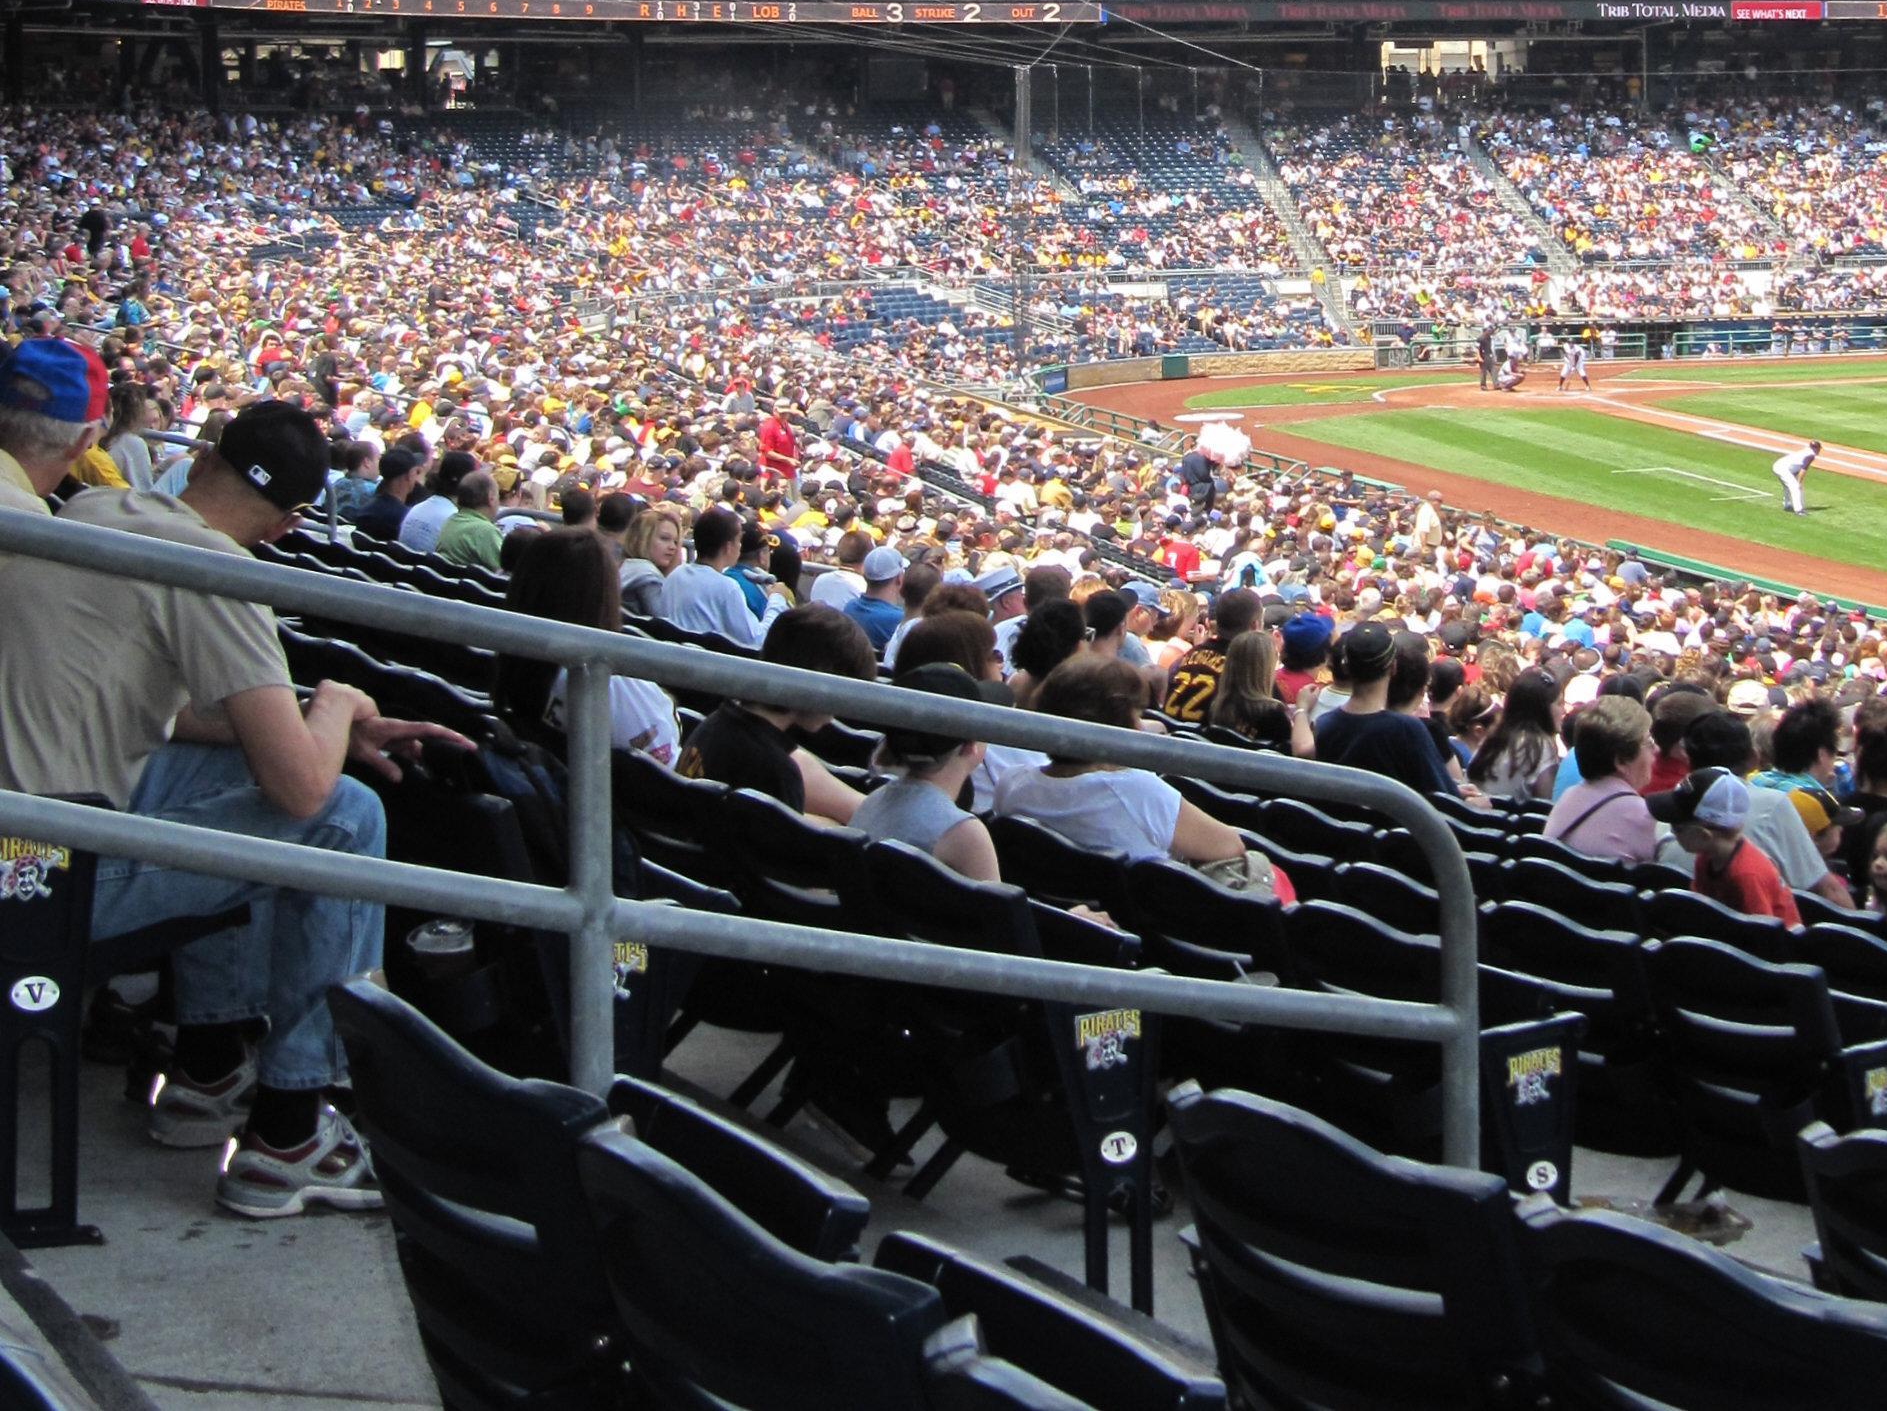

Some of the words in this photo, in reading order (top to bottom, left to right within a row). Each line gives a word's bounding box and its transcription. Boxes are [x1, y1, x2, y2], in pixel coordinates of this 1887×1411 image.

[267, 1, 306, 11] PIRATES
[752, 5, 780, 18] LOB
[852, 8, 878, 18] BALL
[886, 3, 904, 22] 3
[915, 8, 955, 18] STRIKE
[963, 3, 981, 22] 2
[1012, 8, 1035, 18] OUT
[1043, 3, 1060, 22] 2
[1597, 3, 1629, 17] TRIB
[1632, 3, 1679, 17] TOTAL
[1682, 3, 1726, 17] MEDIA
[1736, 8, 1751, 19] SEE
[1752, 8, 1784, 19] WHAT'S
[1786, 8, 1807, 19] NEXT
[1165, 671, 1216, 721] 22
[25, 982, 46, 1004] V
[1079, 1009, 1142, 1050] PIRATES
[1508, 1046, 1562, 1084] PIRATES
[1111, 1138, 1126, 1157] T
[1536, 1166, 1549, 1185] S
